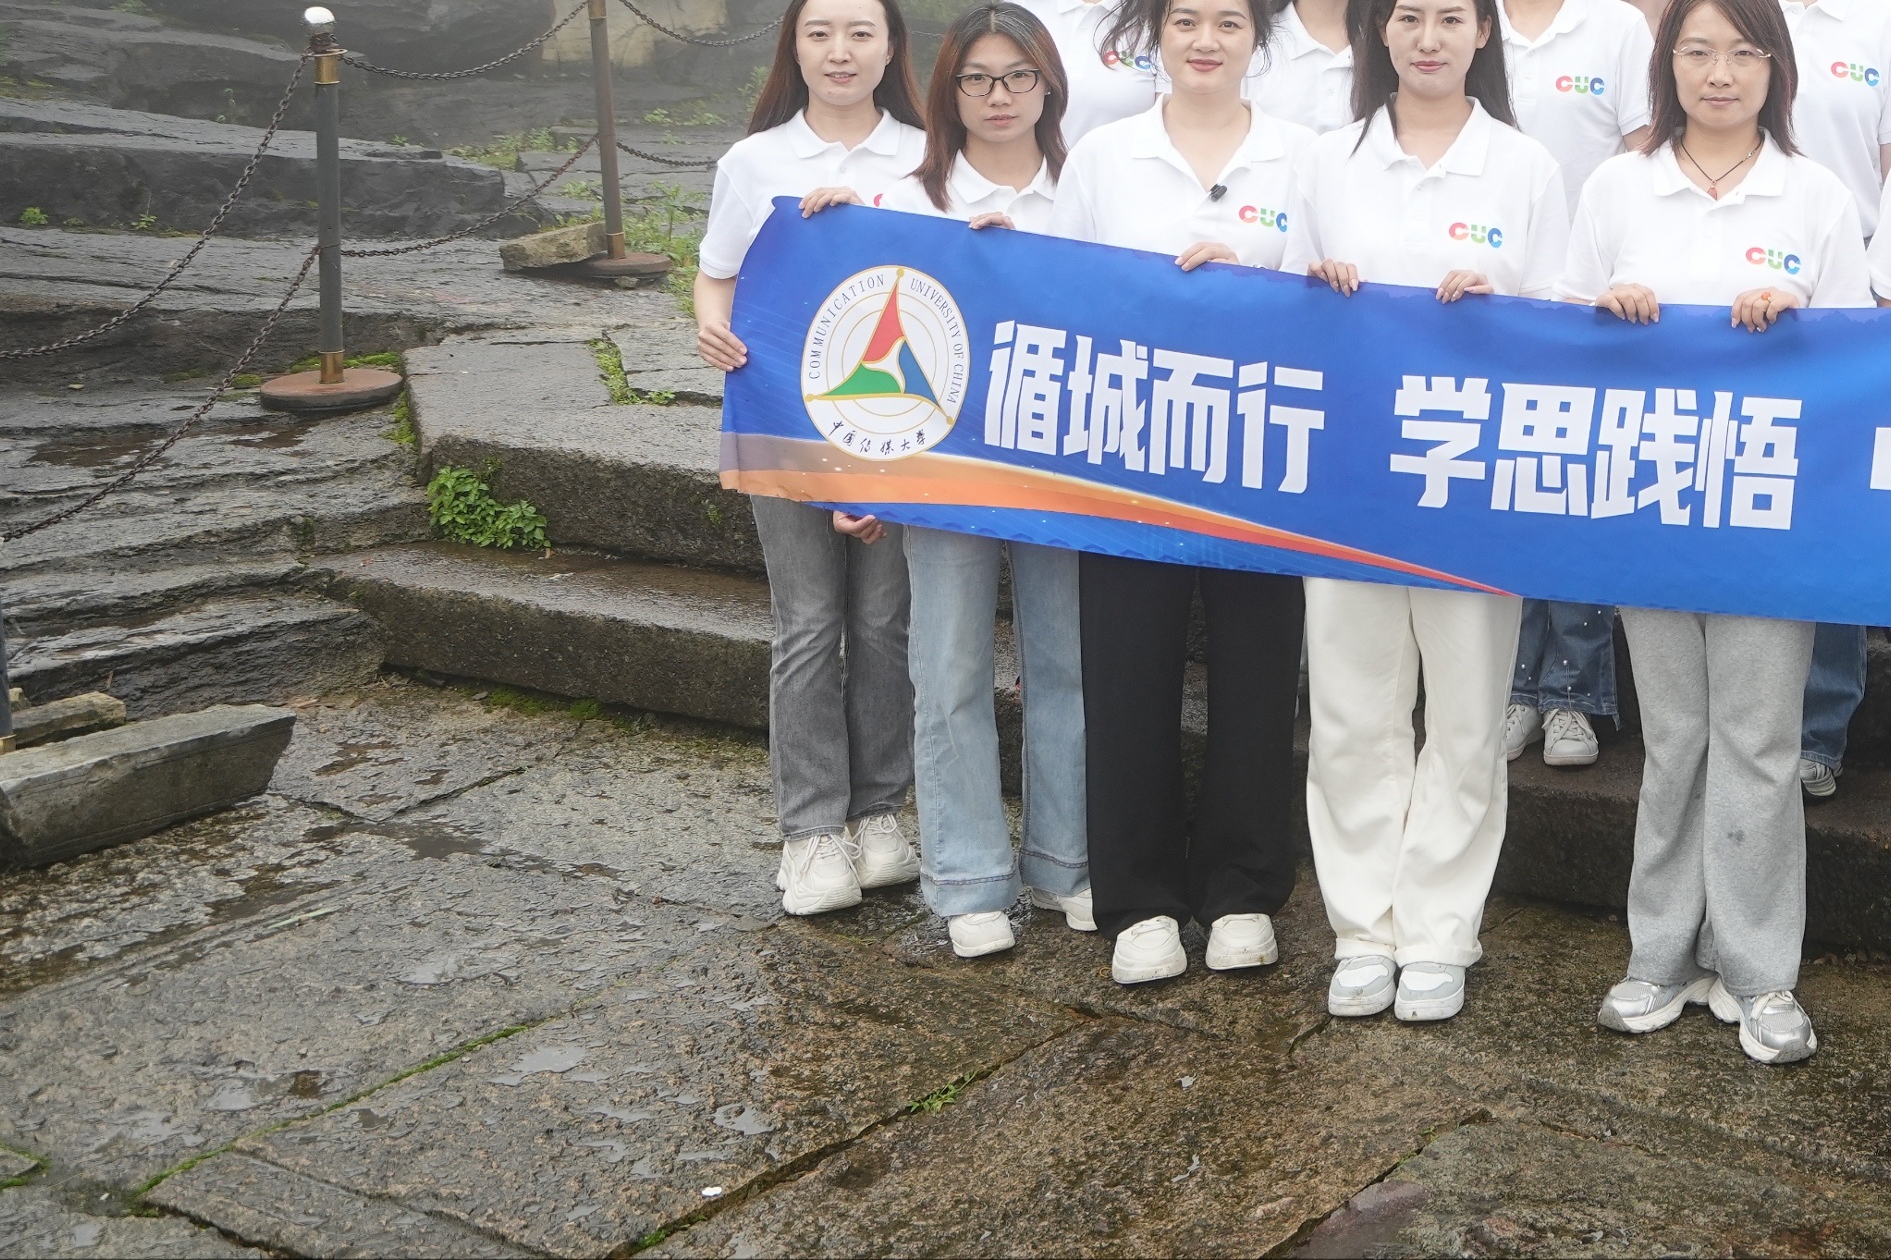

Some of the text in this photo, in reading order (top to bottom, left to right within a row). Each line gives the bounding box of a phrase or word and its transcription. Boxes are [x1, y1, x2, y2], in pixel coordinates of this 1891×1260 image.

[1555, 75, 1605, 96] CUC
[1831, 61, 1880, 87] CUC
[1238, 205, 1288, 233] CUC
[1448, 222, 1503, 248] CUC
[1745, 247, 1801, 275] CUC
[808, 274, 965, 405] COMMUNICATION UNIVERSITY OF CHINA
[983, 320, 1325, 494] 循城而行
[1390, 375, 1802, 531] 学思践悟
